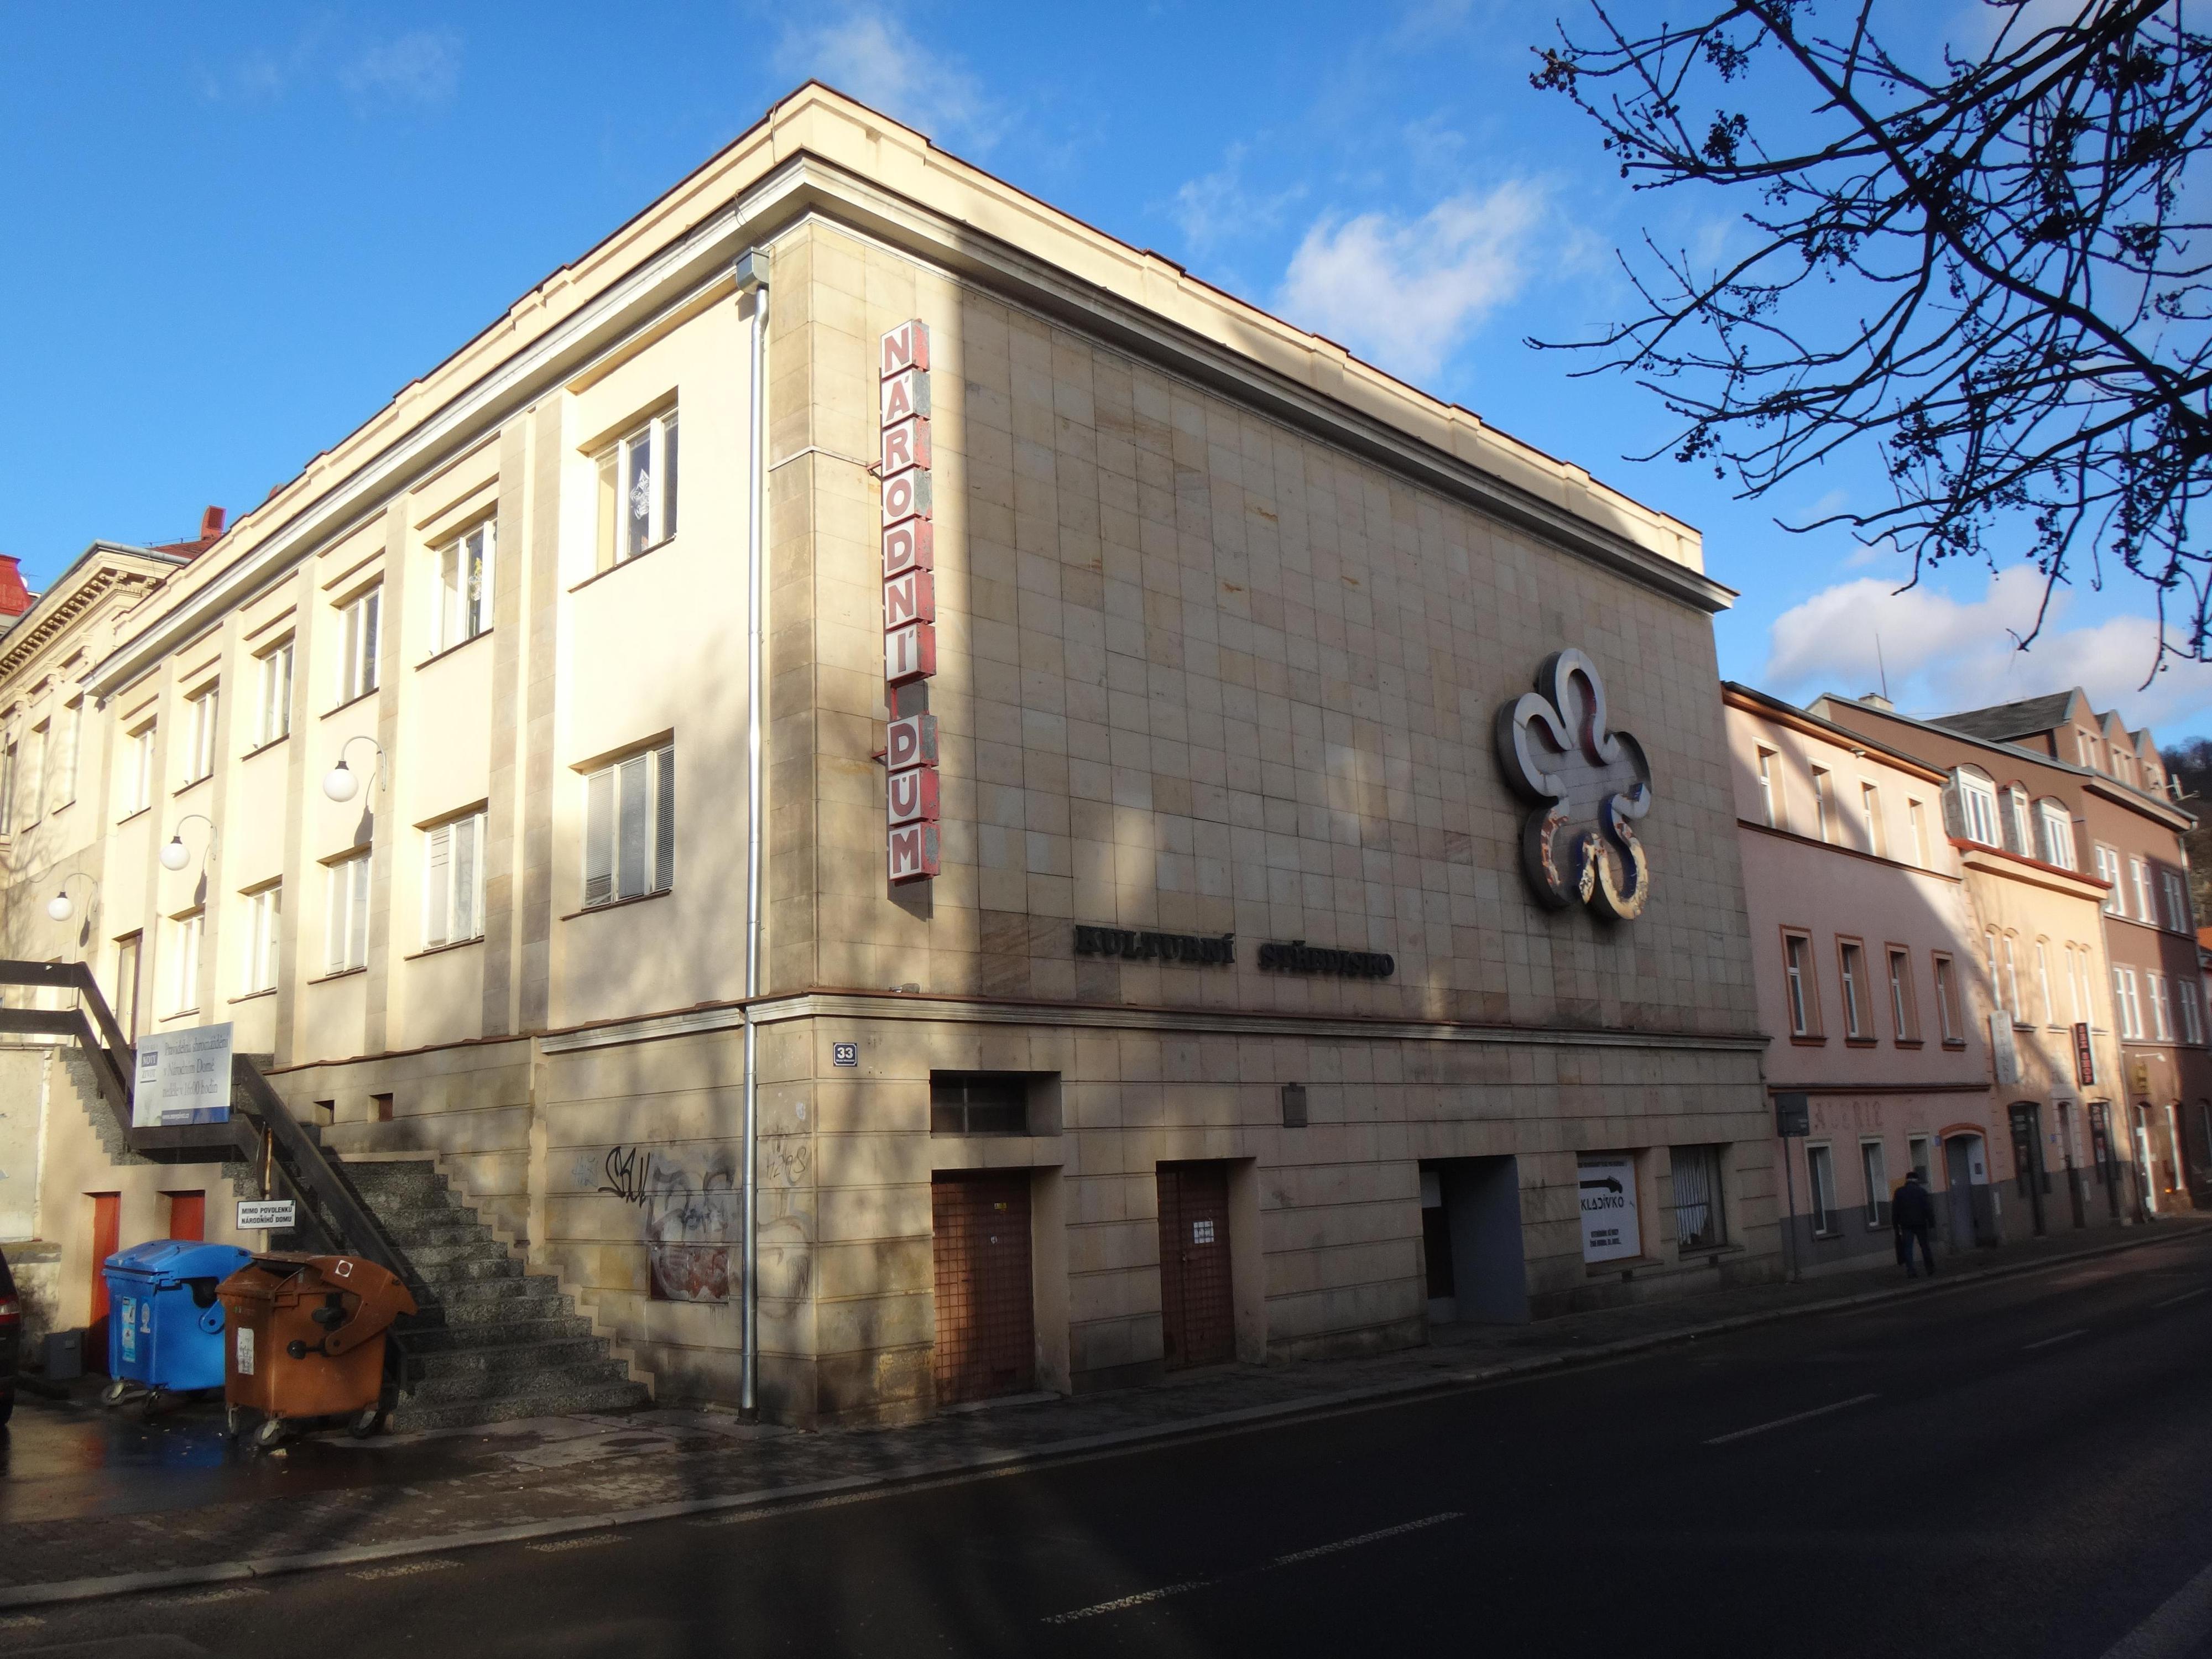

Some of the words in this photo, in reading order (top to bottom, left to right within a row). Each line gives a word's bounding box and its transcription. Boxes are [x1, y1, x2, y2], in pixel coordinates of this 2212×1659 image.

[884, 335, 914, 673] NÁRODNÍ
[1076, 925, 1234, 963] KULTURNÍ
[837, 1047, 853, 1059] 33
